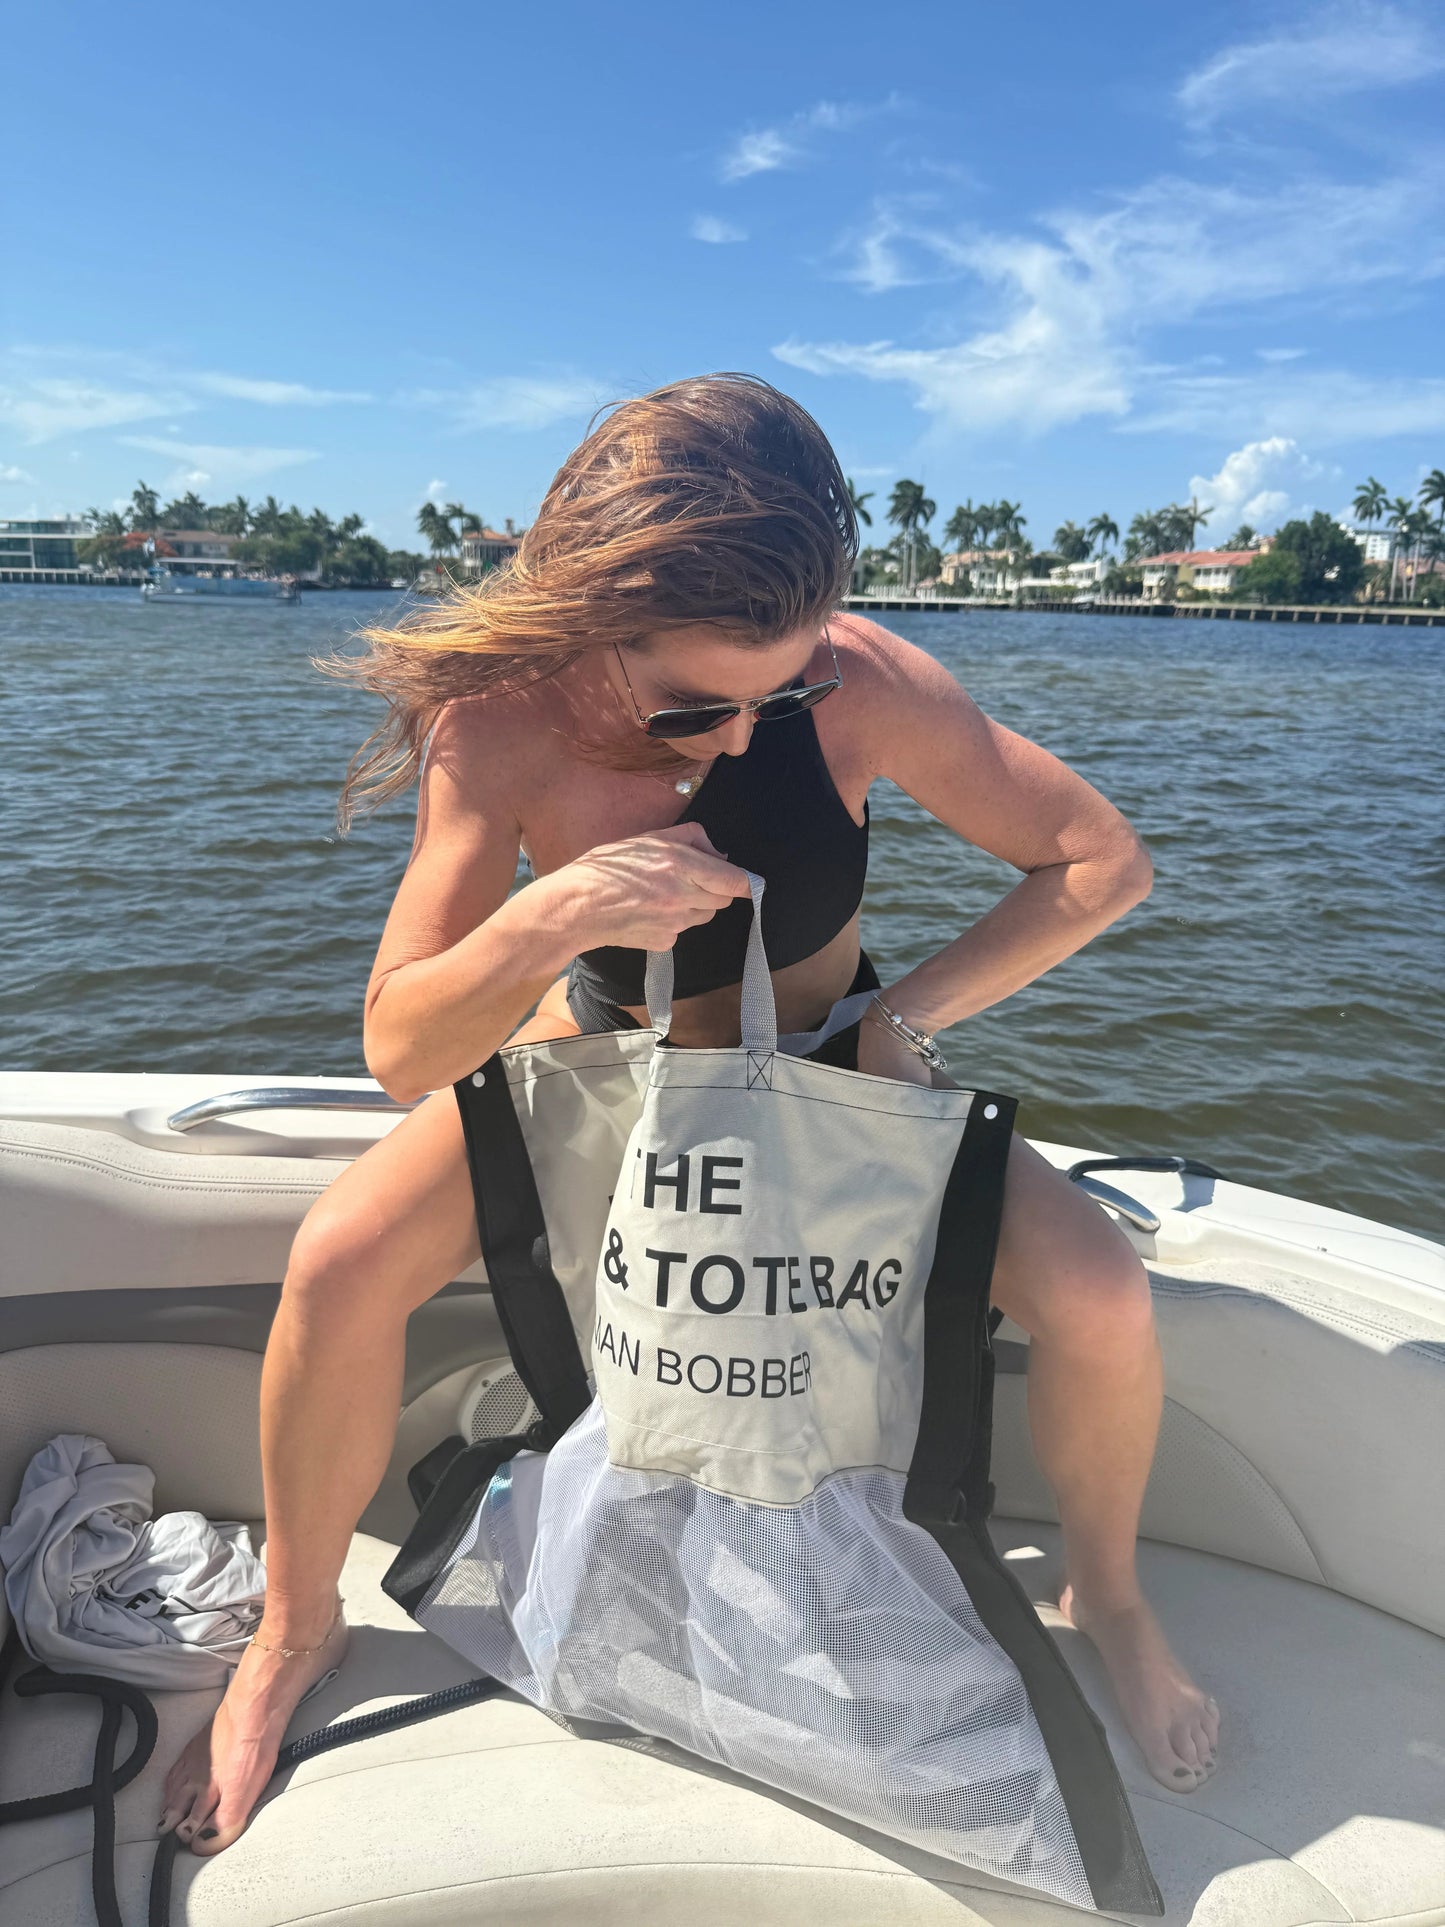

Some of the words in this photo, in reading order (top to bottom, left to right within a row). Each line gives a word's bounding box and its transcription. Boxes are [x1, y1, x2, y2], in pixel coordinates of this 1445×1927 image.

[631, 1148, 744, 1215] HE
[603, 1227, 629, 1291] &
[656, 1347, 812, 1399] BOBBER
